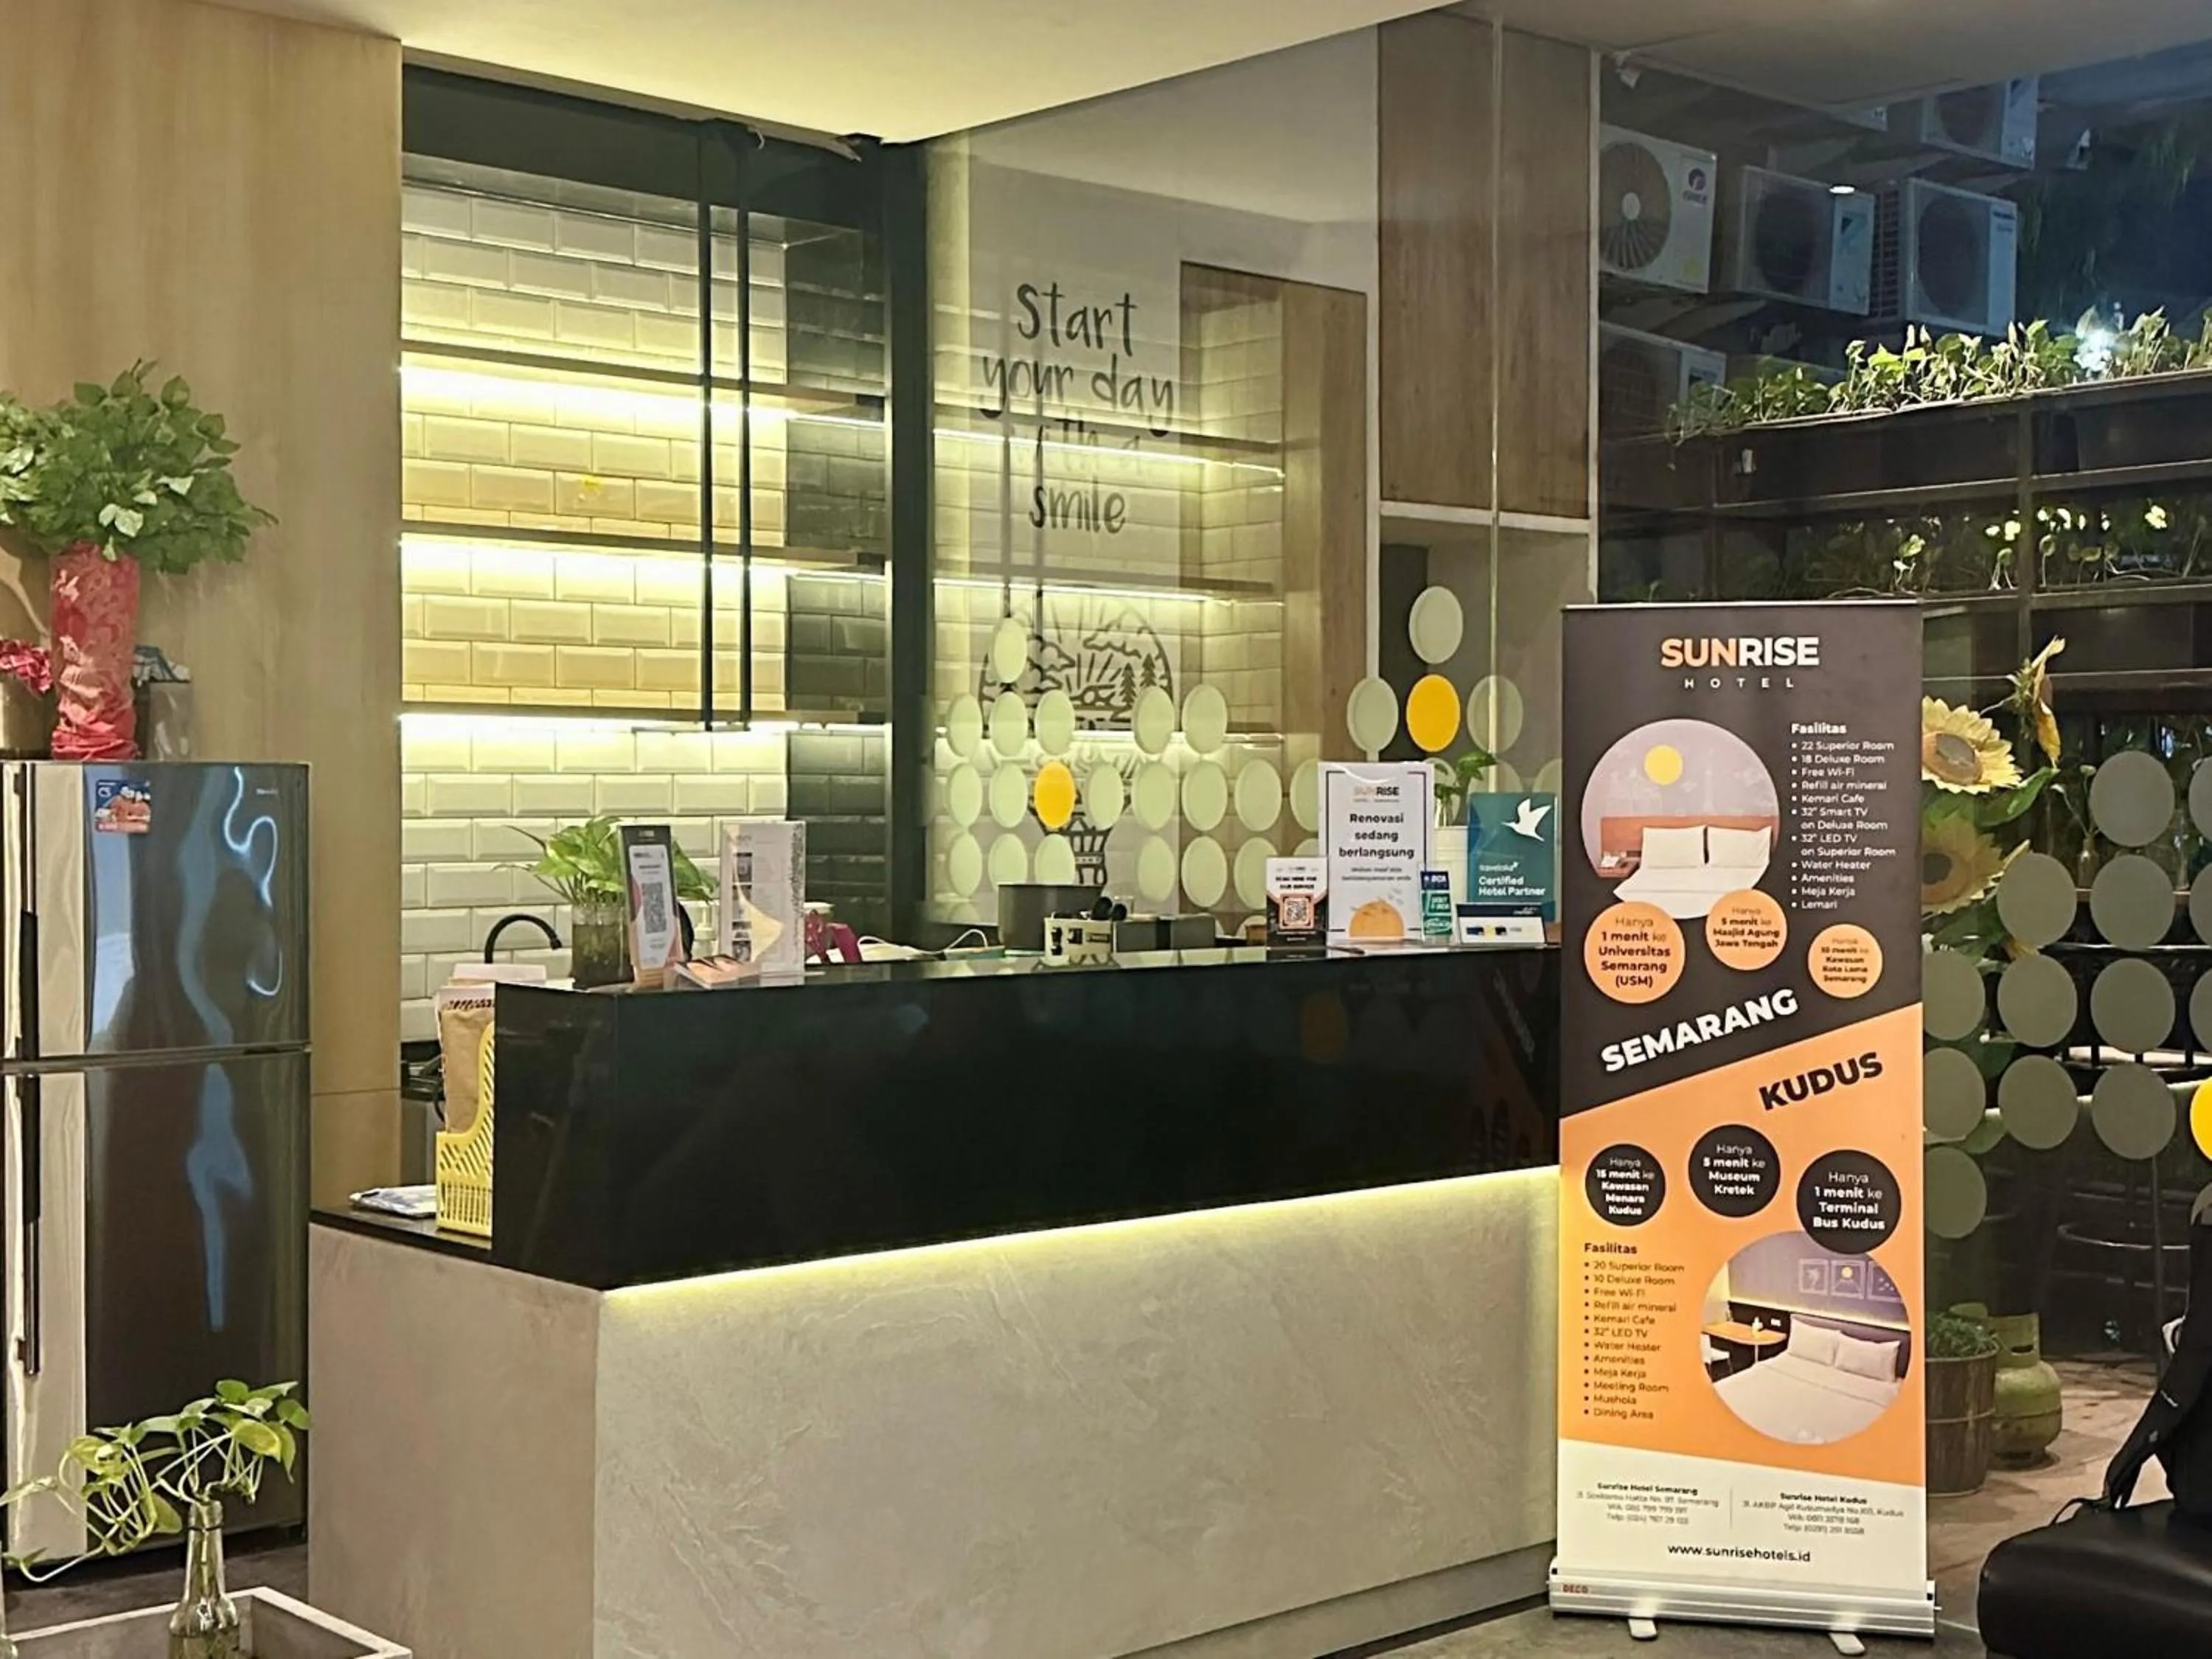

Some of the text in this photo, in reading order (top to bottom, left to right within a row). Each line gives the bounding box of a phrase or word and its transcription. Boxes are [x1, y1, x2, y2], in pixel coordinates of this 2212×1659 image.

[1017, 282, 1137, 357] Start
[980, 353, 1173, 437] your day
[1029, 473, 1125, 534] smile
[1660, 636, 1820, 667] SUNRISE
[1684, 678, 1794, 688] HOTEL
[1791, 722, 1847, 734] Fasilitas
[1801, 742, 1894, 751] 22 Superior Room
[1815, 754, 1851, 764] Deluxe
[1853, 754, 1885, 763] Room
[1801, 768, 1854, 776] Free Wi-Fi
[1801, 780, 1887, 790] Refill air mineral
[1801, 794, 1865, 803] Kemari Cafe
[1820, 807, 1851, 816] Smart
[1854, 807, 1868, 816] TV
[1349, 813, 1404, 824] Renovasi
[1801, 820, 1888, 830] on Deluxe Room
[1354, 830, 1399, 843] sedang
[1820, 834, 1841, 843] LED
[1844, 834, 1857, 843] TV
[1338, 846, 1415, 859] berlangsung
[1801, 847, 1896, 858] on Superior Room
[1801, 860, 1871, 869] Water Heater
[1478, 875, 1524, 886] Certified
[1801, 874, 1854, 883] Amenities
[1478, 886, 1546, 896] Hotel Partner
[1801, 886, 1856, 898] Meja Kerja
[1801, 900, 1837, 909] Lemari
[1615, 917, 1654, 928] Hanya
[1730, 917, 1758, 925] menit
[1601, 931, 1607, 941] 1
[1611, 931, 1649, 942] menit
[1713, 928, 1780, 939] Masjid Agung
[1742, 939, 1778, 949] Tengah
[1599, 945, 1671, 957] Universitas
[1601, 961, 1667, 973] Semarang
[1615, 975, 1653, 988] (USM)
[1601, 989, 1798, 1072] SEMARANG
[1759, 1051, 1882, 1110] KUDUS
[1716, 1144, 1753, 1156] Hanya
[1714, 1157, 1749, 1168] menit
[1752, 1158, 1766, 1169] ke
[1608, 1169, 1641, 1179] menit
[1708, 1171, 1760, 1181] Museum
[1828, 1171, 1869, 1184] Hanya
[1601, 1181, 1649, 1192] Kawasan
[1714, 1184, 1755, 1195] Kretek
[1605, 1193, 1645, 1203] Menara
[1814, 1186, 1882, 1199] 1 menit ke
[1608, 1206, 1642, 1215] Kudus
[1818, 1201, 1879, 1214] Terminal
[1813, 1217, 1885, 1230] Bus Kudus
[1584, 1242, 1638, 1254] Fasilitas
[1609, 1261, 1651, 1272] Superior
[1654, 1263, 1685, 1272] Room
[1607, 1274, 1641, 1284] Deluxe
[1644, 1276, 1675, 1285] Room
[1593, 1287, 1615, 1297] Free
[1593, 1300, 1677, 1312] Refill air mineral
[1593, 1314, 1655, 1325] Kemari Cafe
[1611, 1328, 1632, 1338] LED
[1635, 1329, 1648, 1338] TV
[1594, 1340, 1661, 1352] Water Heater
[1593, 1354, 1645, 1365] Amenities
[1593, 1367, 1647, 1380] Meja Kerja
[1593, 1381, 1669, 1394] Meeting Room
[1593, 1408, 1654, 1420] Dining Area
[1840, 1495, 1868, 1505] Kudus
[1668, 1545, 1810, 1562] www.sunrisehotels.id
